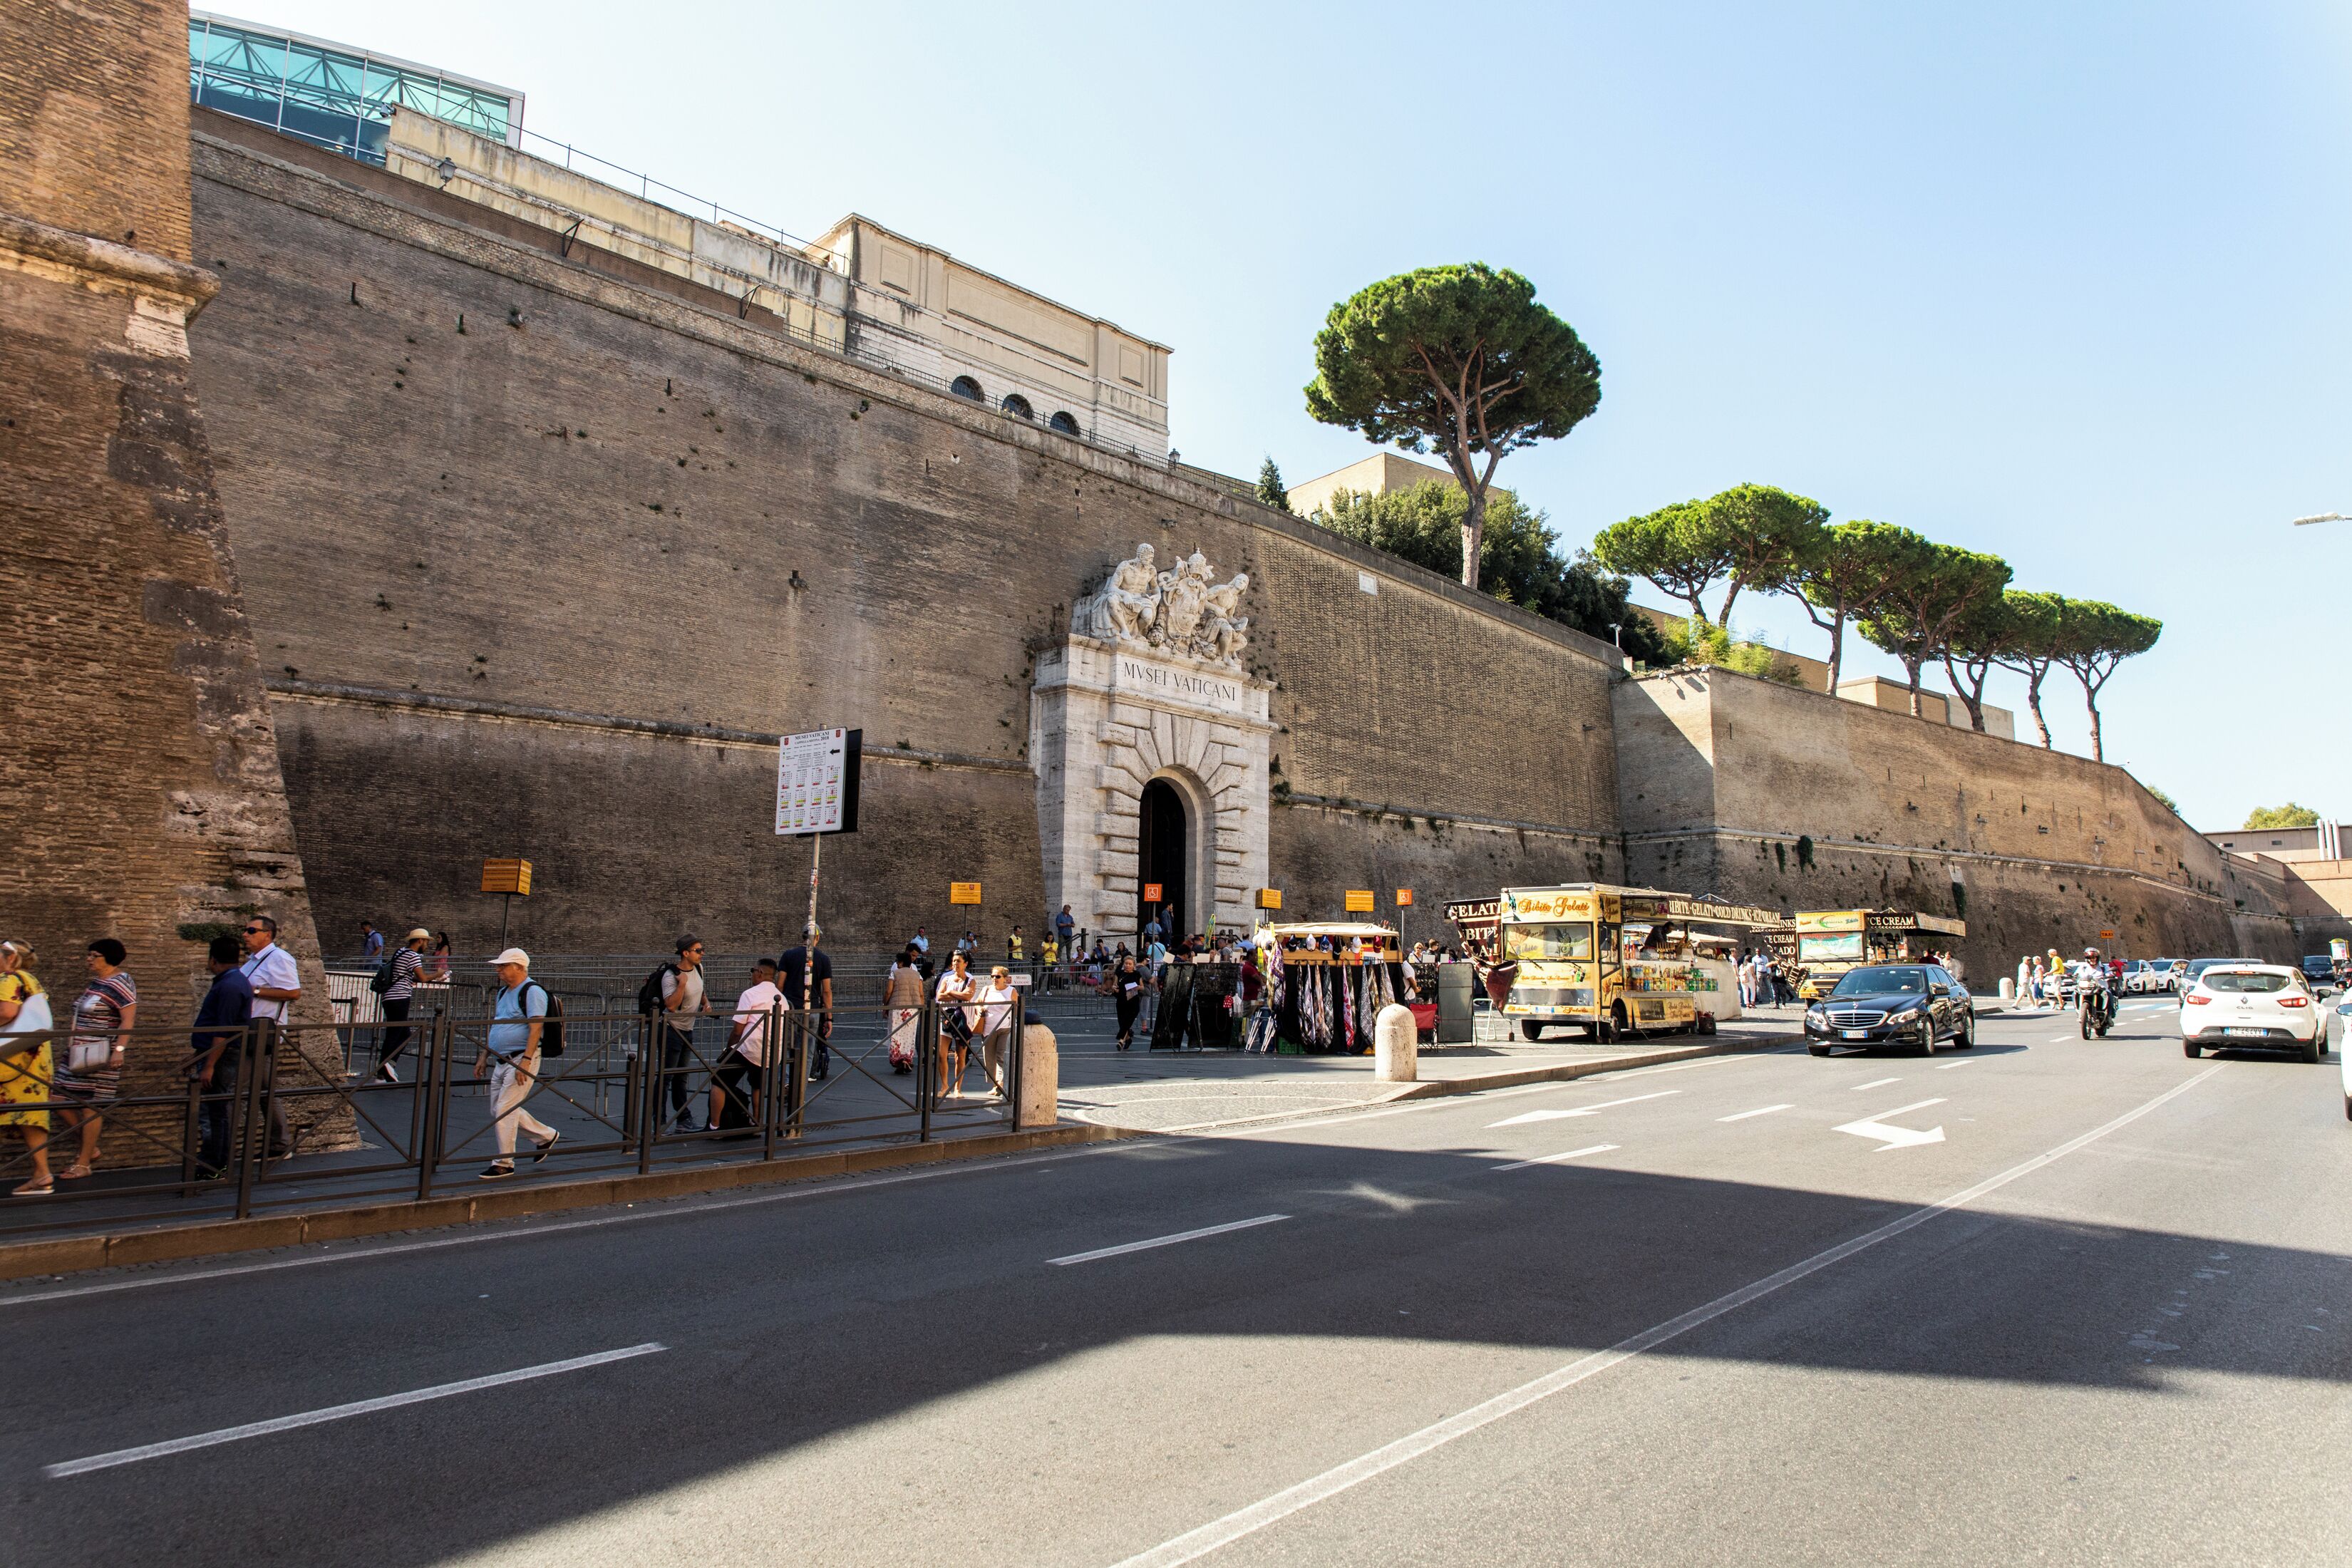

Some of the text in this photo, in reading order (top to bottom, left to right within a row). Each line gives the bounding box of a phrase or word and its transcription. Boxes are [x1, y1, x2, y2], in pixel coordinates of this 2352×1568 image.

[1125, 662, 1235, 701] MVSEI VATICANI
[1517, 899, 1552, 914] Bibite
[1552, 897, 1590, 917] Gelati
[1691, 902, 1713, 917] GELATI
[1715, 905, 1731, 919] COLD
[1731, 907, 1752, 921] DRINKS
[1762, 911, 1780, 923] CREAM
[1882, 917, 1914, 926] CREAM
[1773, 934, 1795, 944] CREAM
